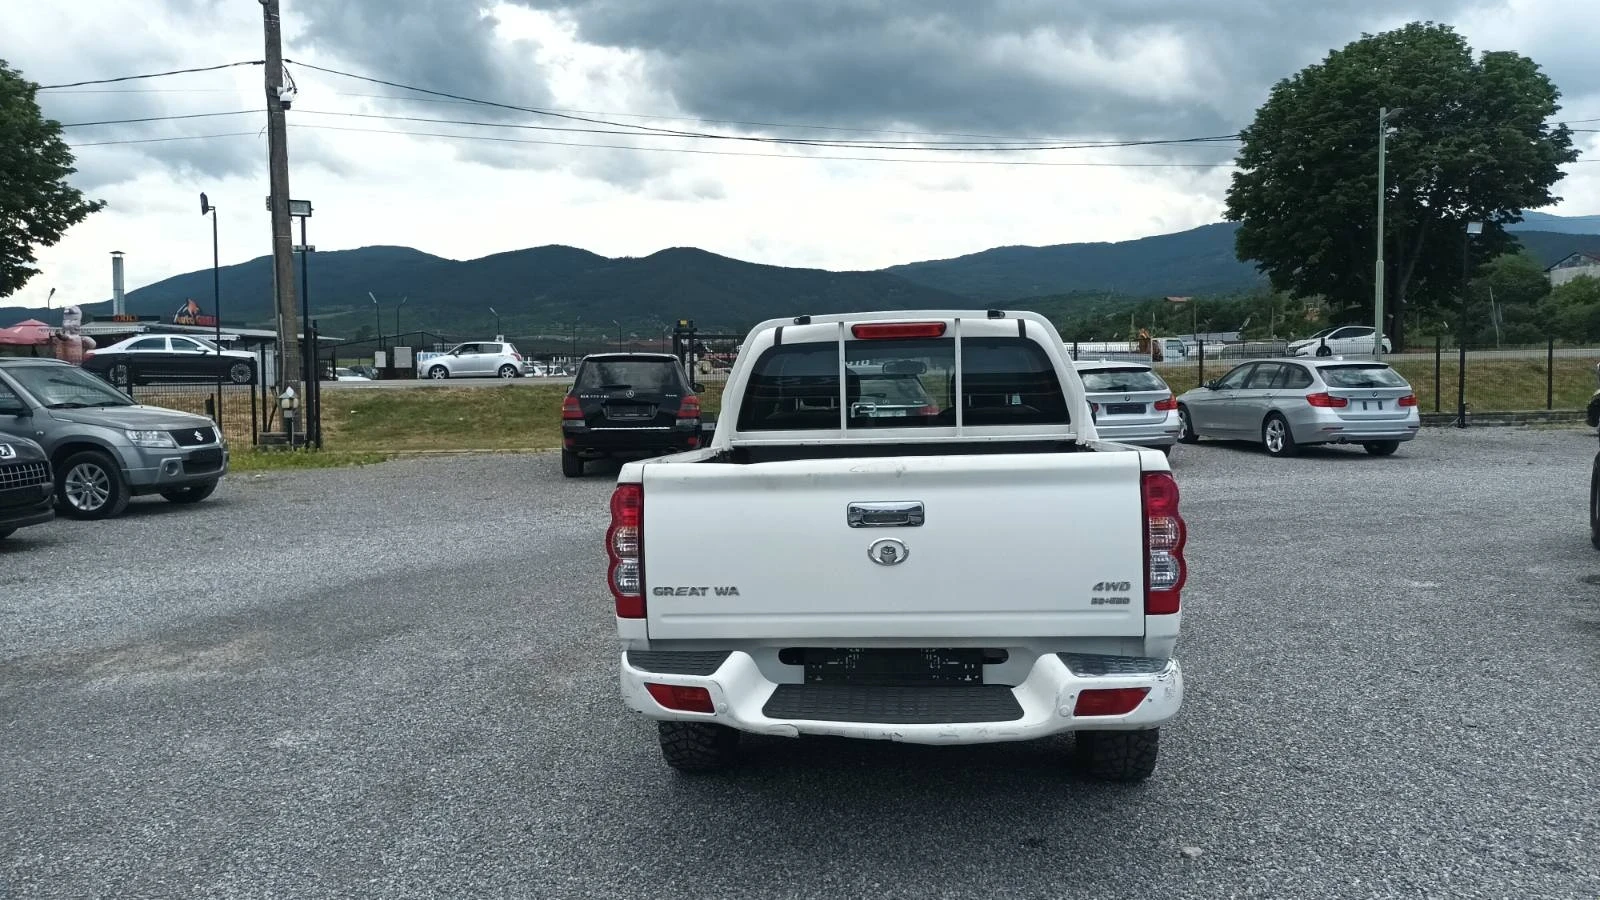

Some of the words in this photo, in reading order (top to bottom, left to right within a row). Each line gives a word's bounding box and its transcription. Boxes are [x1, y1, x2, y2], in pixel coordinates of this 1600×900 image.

[652, 586, 709, 597] GREAT
[714, 586, 740, 597] WA
[1092, 581, 1131, 592] 4WD
